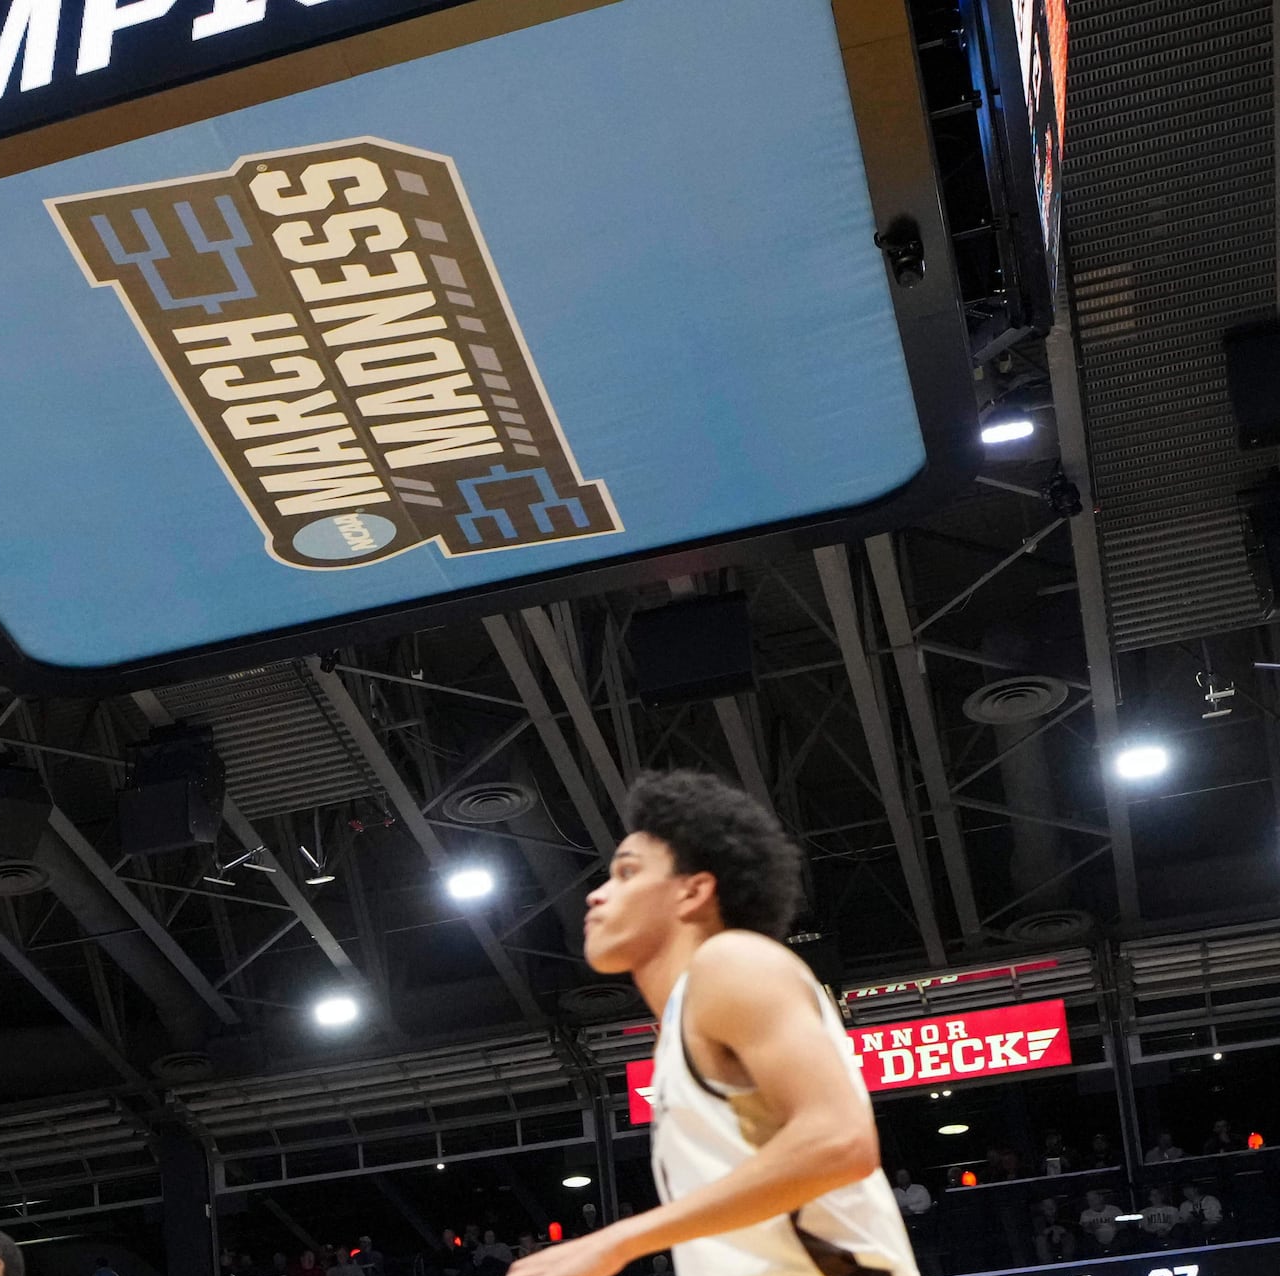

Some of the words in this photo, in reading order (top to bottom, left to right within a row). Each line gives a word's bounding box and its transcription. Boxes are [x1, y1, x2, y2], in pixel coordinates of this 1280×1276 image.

[171, 312, 392, 516] MARCH
[248, 156, 505, 470] MADNESS
[878, 1031, 1028, 1084] DECK
